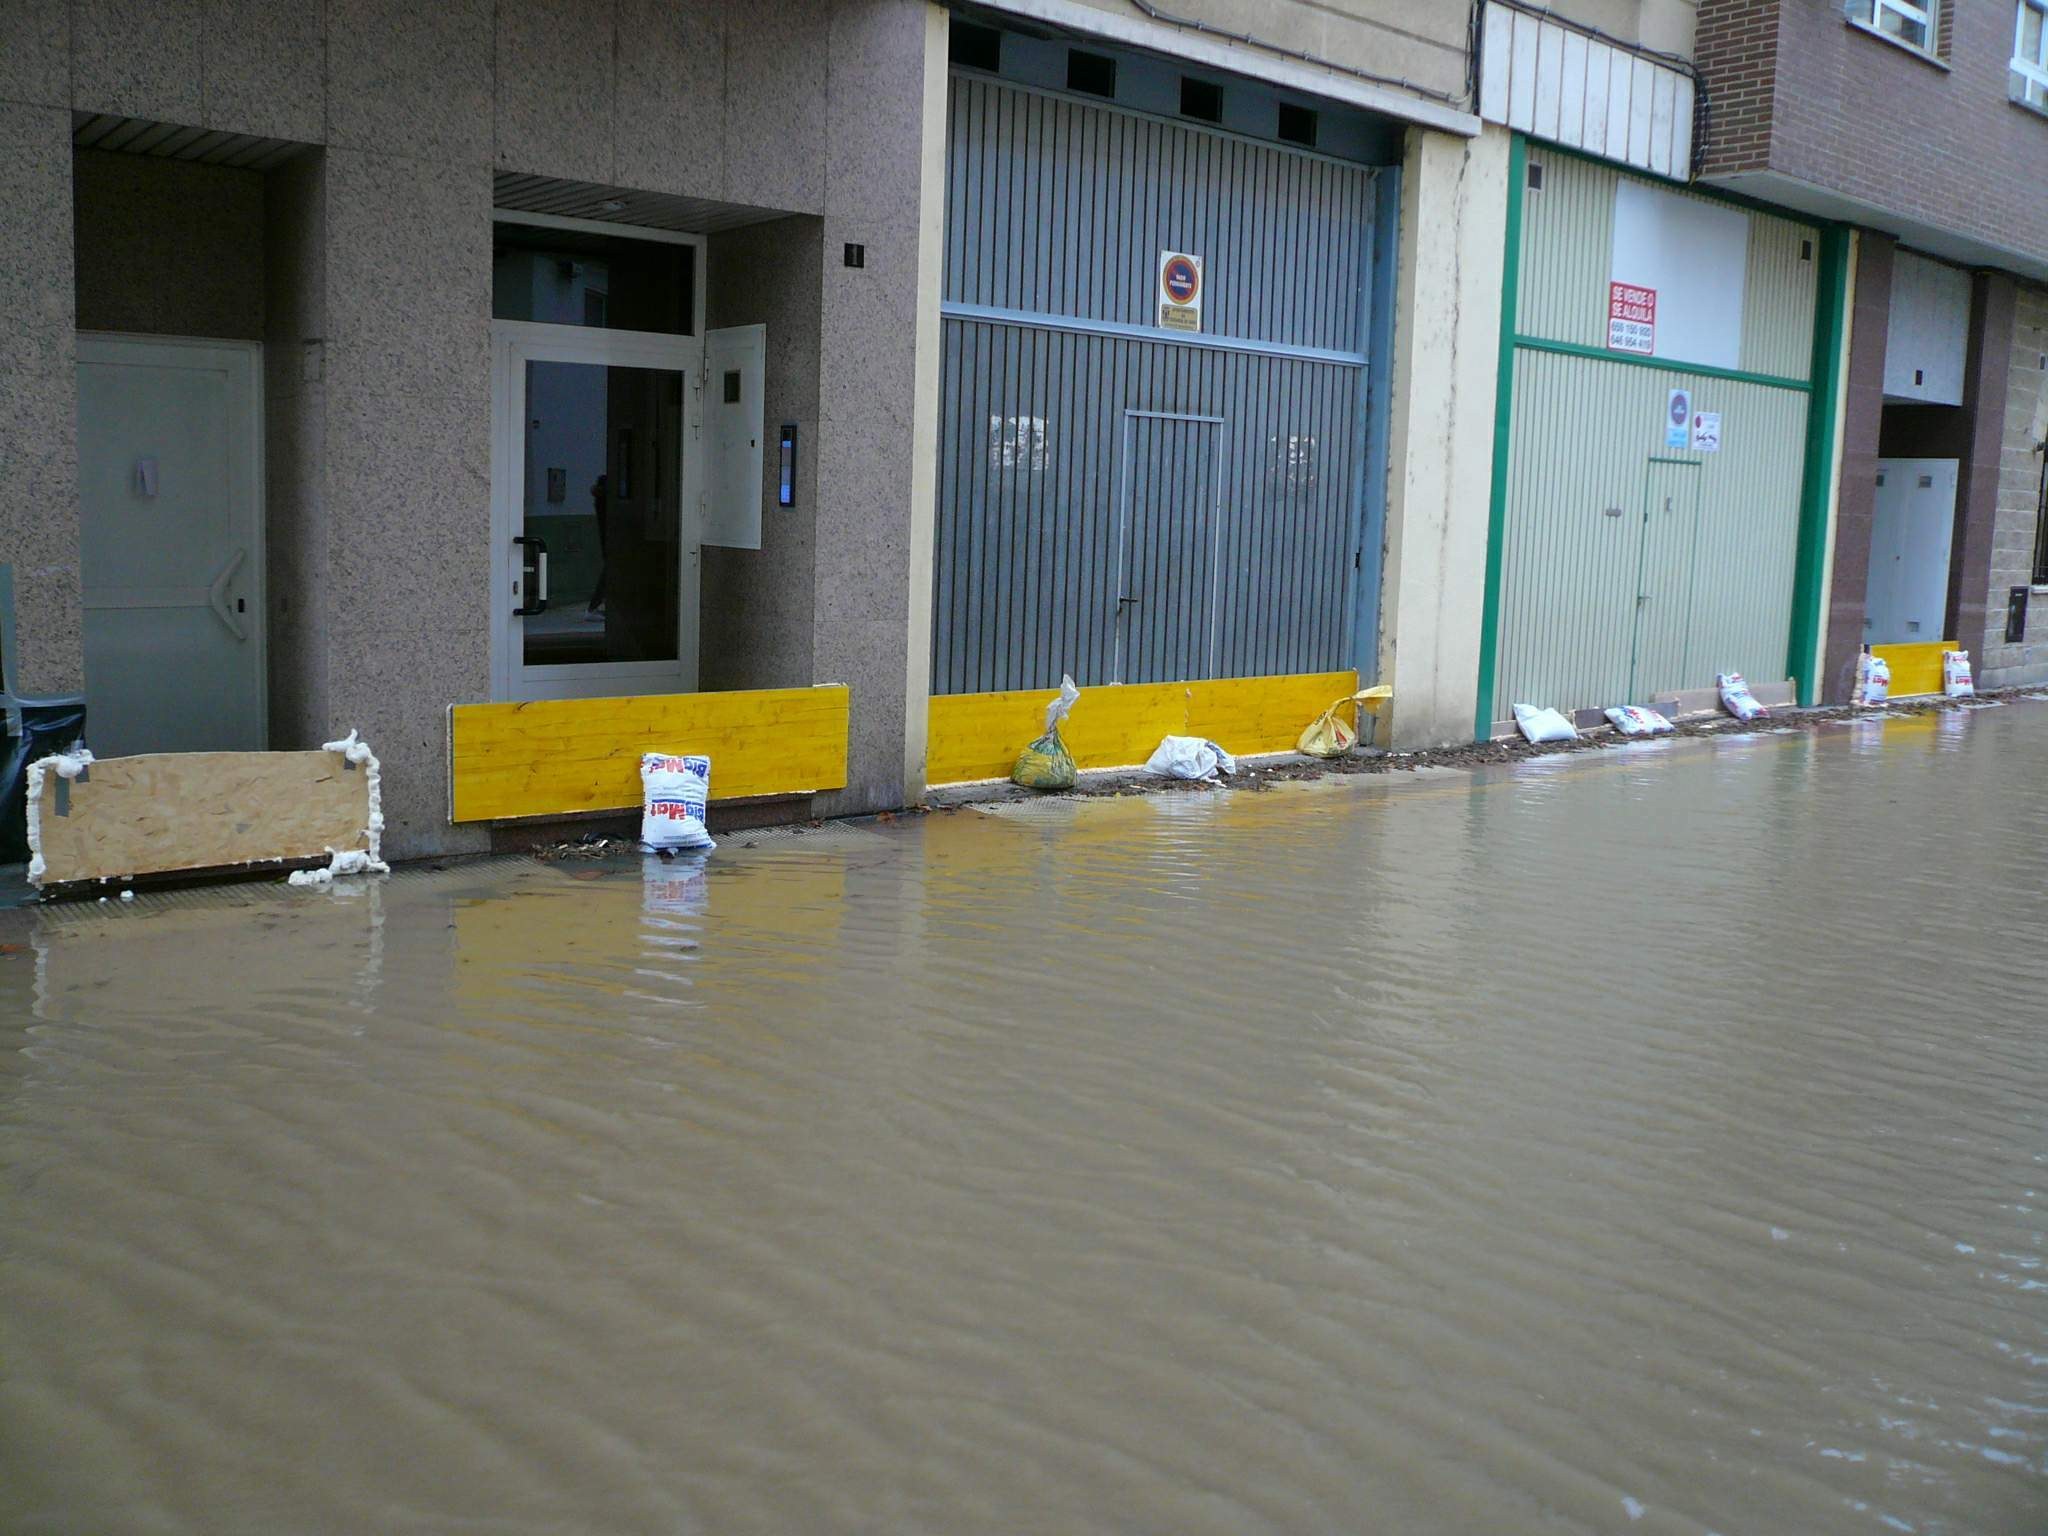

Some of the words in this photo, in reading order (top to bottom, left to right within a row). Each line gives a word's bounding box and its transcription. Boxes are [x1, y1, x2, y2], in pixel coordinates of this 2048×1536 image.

[1612, 285, 1623, 302] SE
[1624, 287, 1648, 306] VENDE
[1648, 292, 1654, 307] O
[1612, 301, 1623, 317] SE
[1623, 303, 1653, 322] ALQUILA
